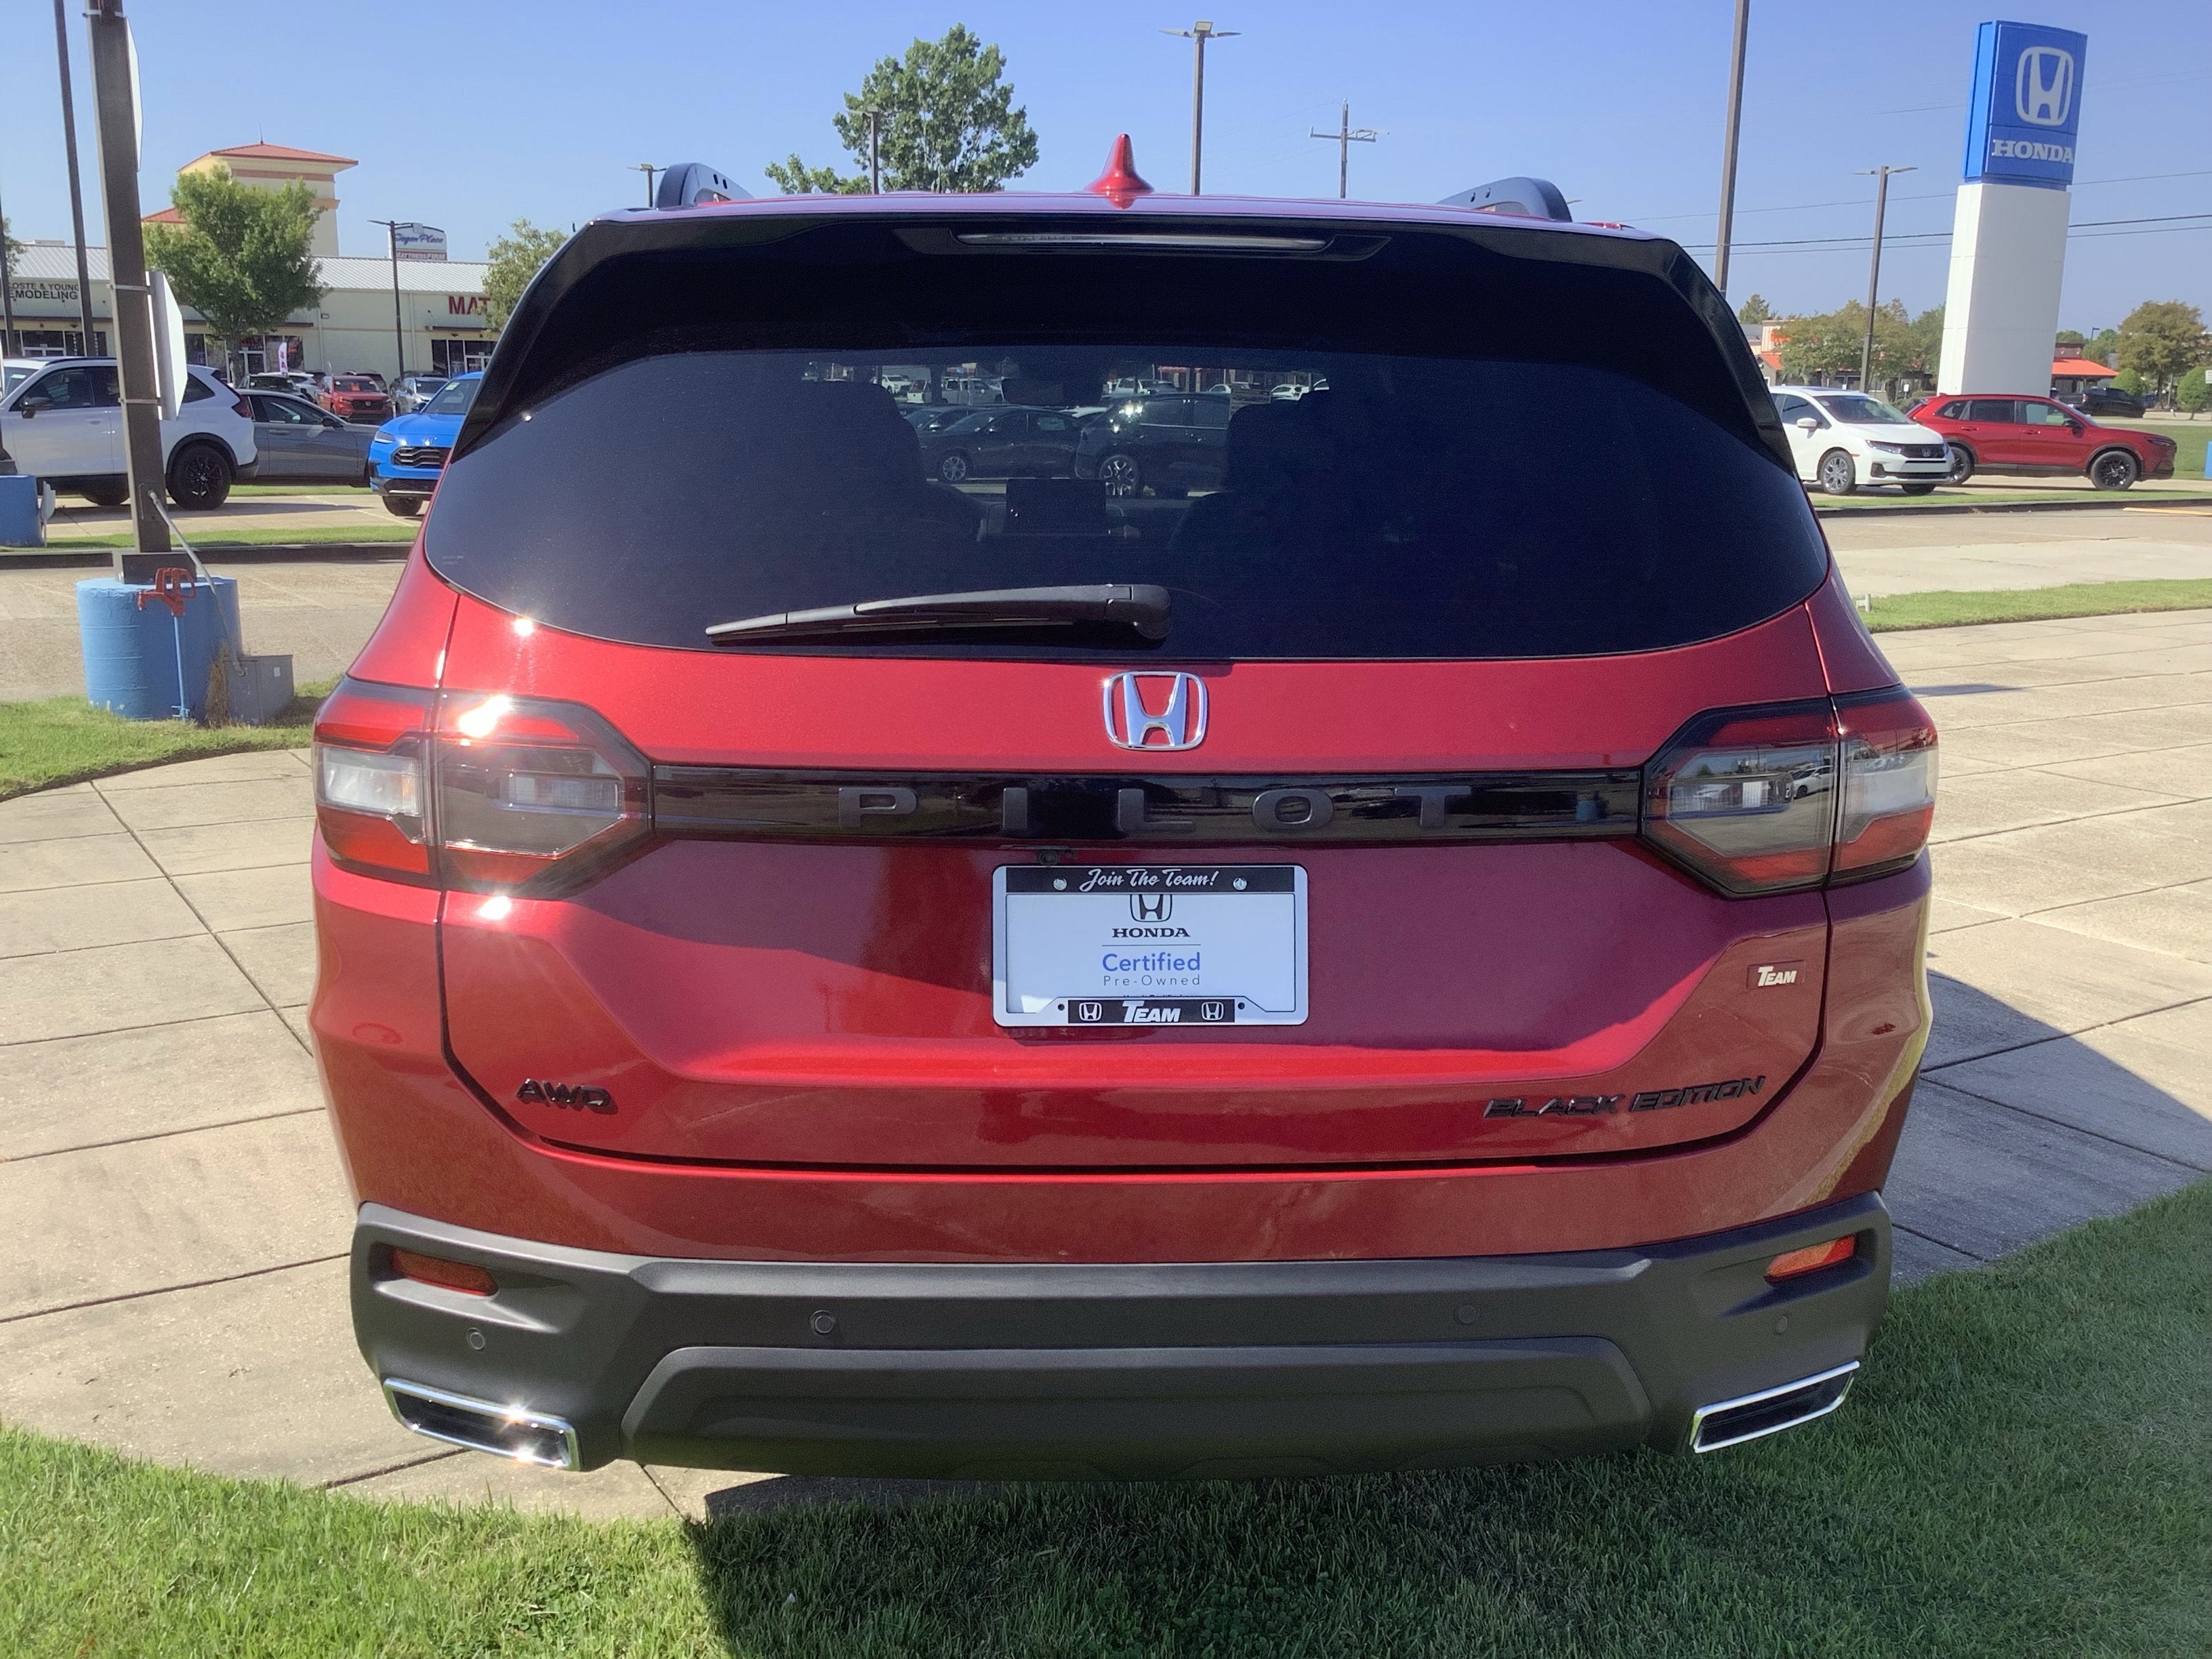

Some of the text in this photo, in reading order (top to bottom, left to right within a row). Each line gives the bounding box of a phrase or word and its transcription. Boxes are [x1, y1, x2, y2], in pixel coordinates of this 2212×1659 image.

[1992, 139, 2074, 164] HONDA
[9, 283, 37, 291] OSTE
[9, 290, 78, 300] EMODELING
[449, 295, 491, 314] MAT
[838, 785, 1472, 834] PILOT
[1079, 868, 1219, 892] Join The Team!
[1111, 928, 1191, 938] HONDA
[1102, 951, 1201, 972] Certified
[1103, 974, 1200, 986] Pre-Owned
[516, 1078, 612, 1107] AWD
[1483, 1075, 1766, 1119] BLACK EDITION
